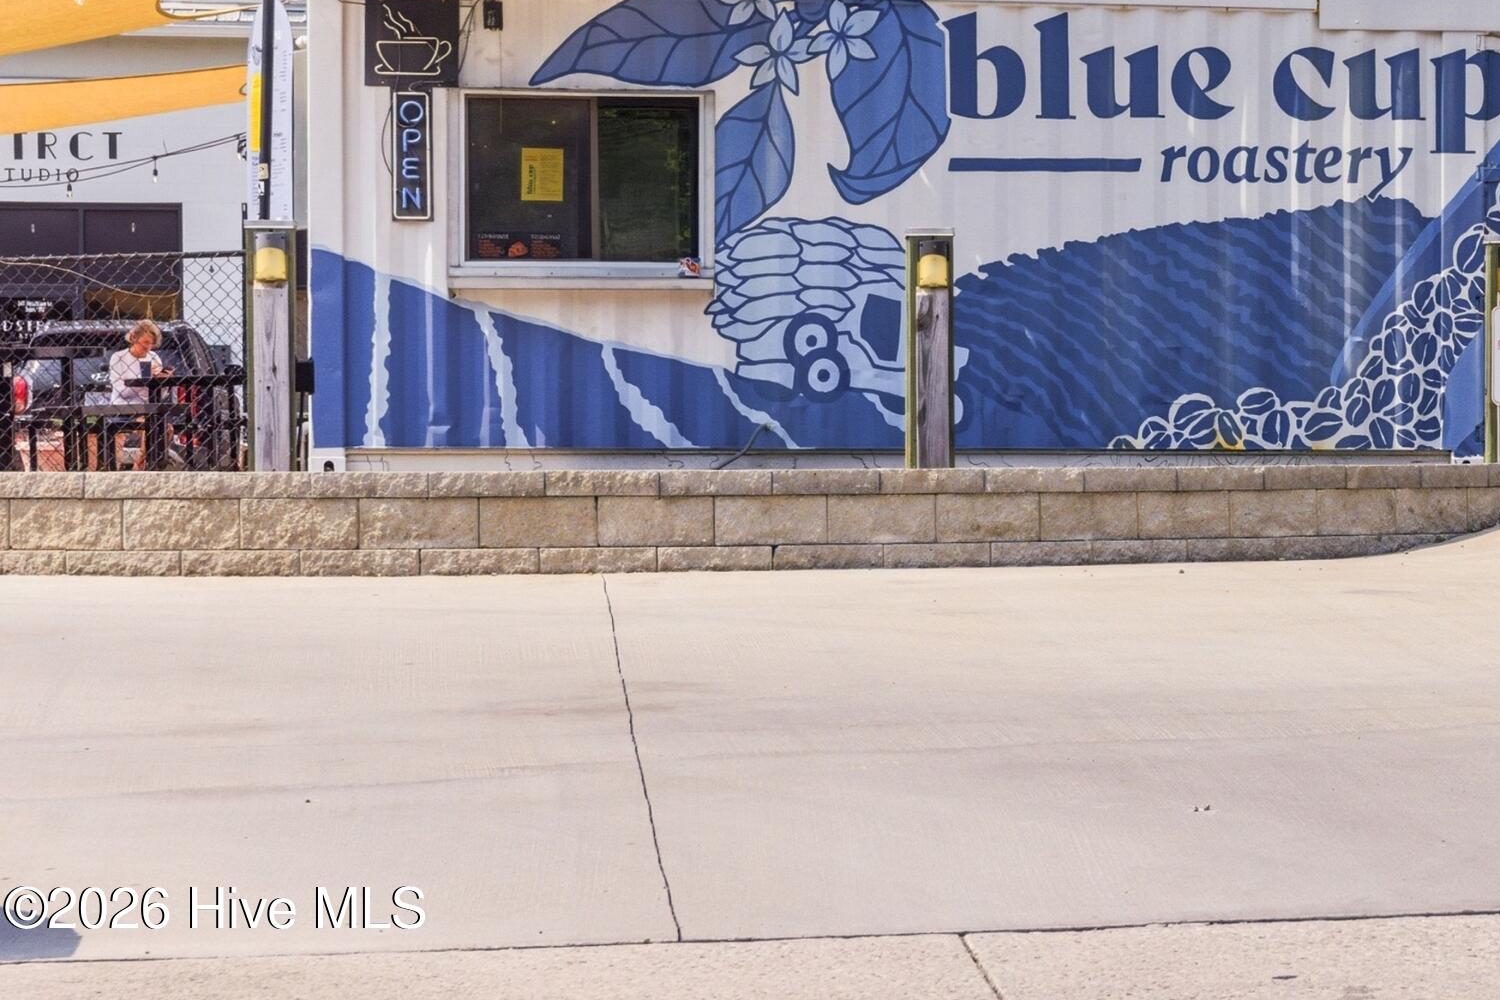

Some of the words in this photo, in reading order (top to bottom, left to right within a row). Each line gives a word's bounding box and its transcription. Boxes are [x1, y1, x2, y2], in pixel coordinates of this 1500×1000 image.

[942, 11, 1236, 121] blue
[400, 100, 424, 209] OPEN
[1159, 139, 1414, 200] roastery
